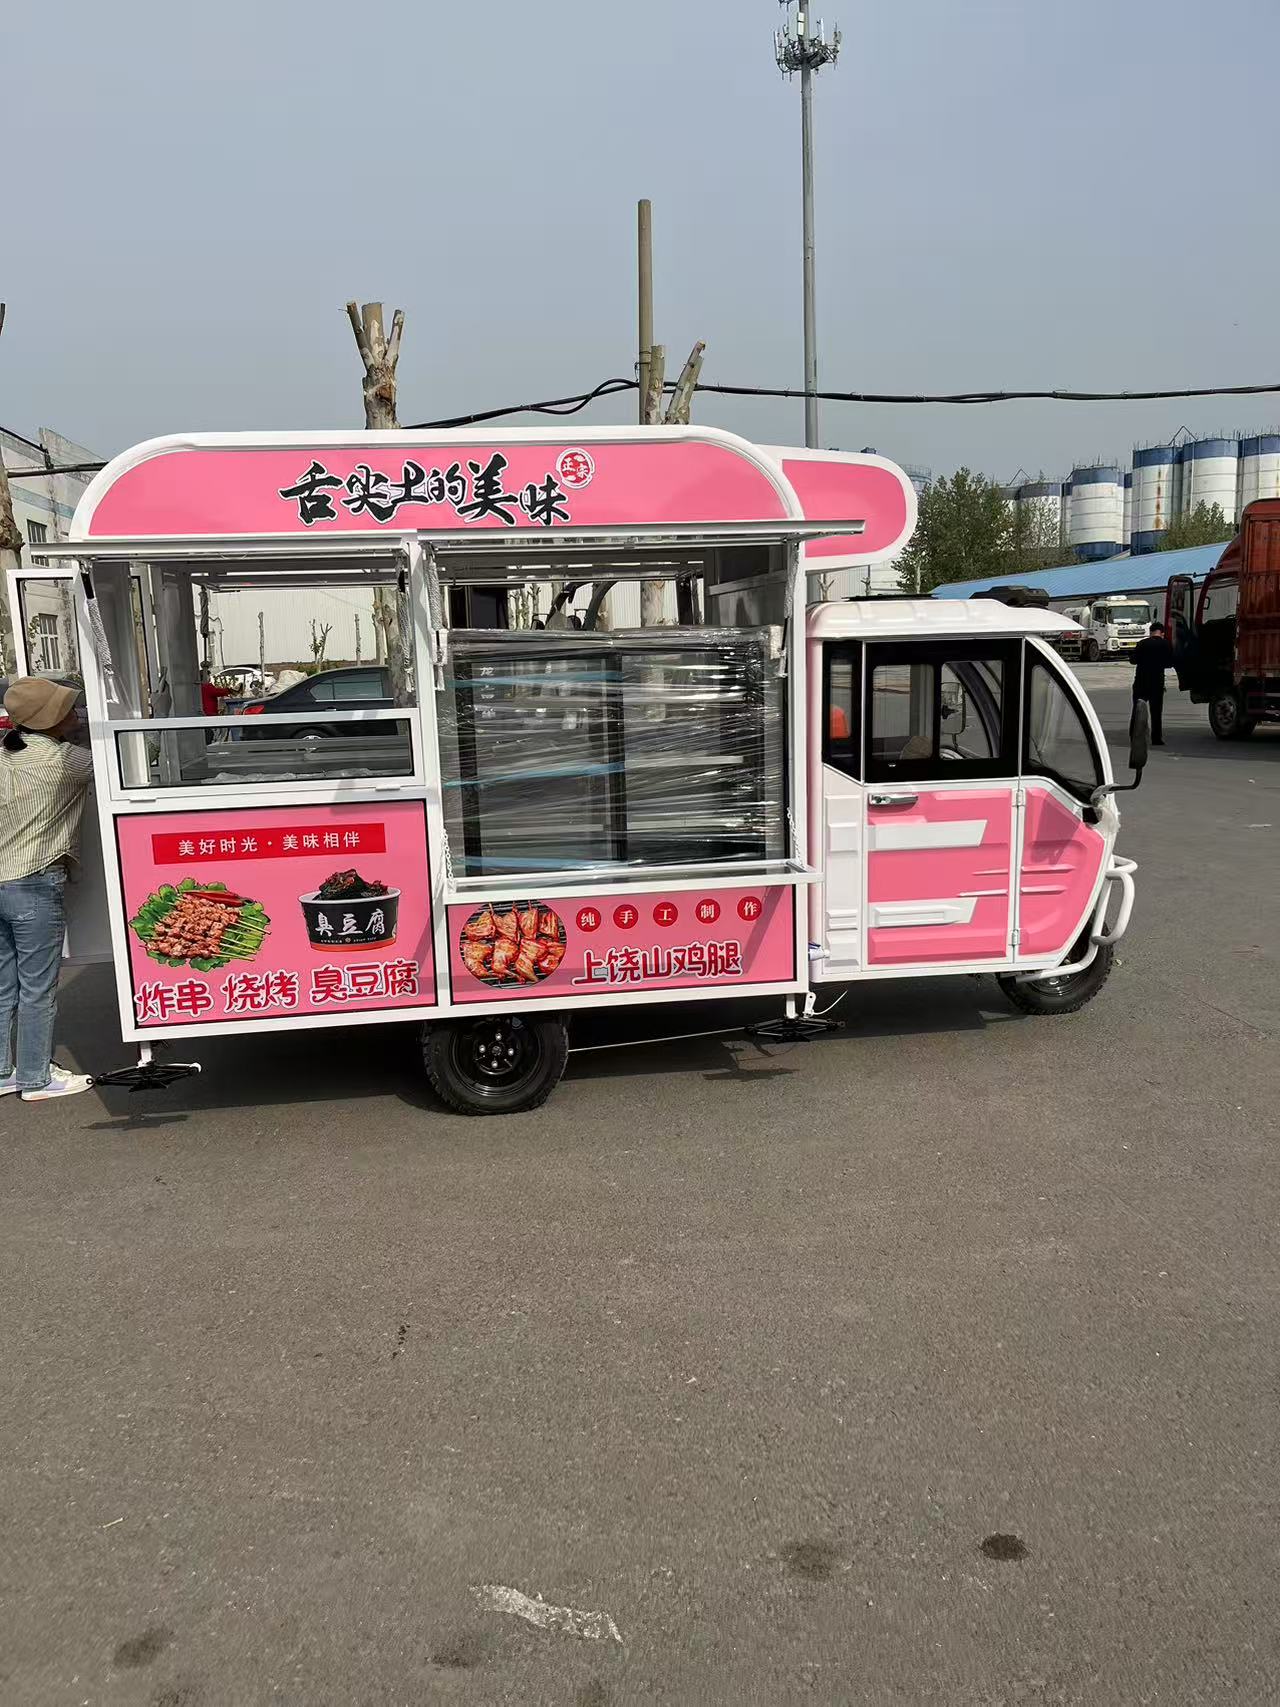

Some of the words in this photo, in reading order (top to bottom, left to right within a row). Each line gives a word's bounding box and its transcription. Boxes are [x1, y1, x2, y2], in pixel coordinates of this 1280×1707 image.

[280, 453, 571, 525] 舌尖上的美味
[561, 456, 589, 479] 正宗
[314, 907, 387, 937] 臭豆腐
[573, 941, 743, 985] 上饶山鸡腿
[136, 979, 214, 1021] 炸串
[222, 969, 299, 1013] 烧烤
[311, 958, 419, 1004] 臭豆腐
